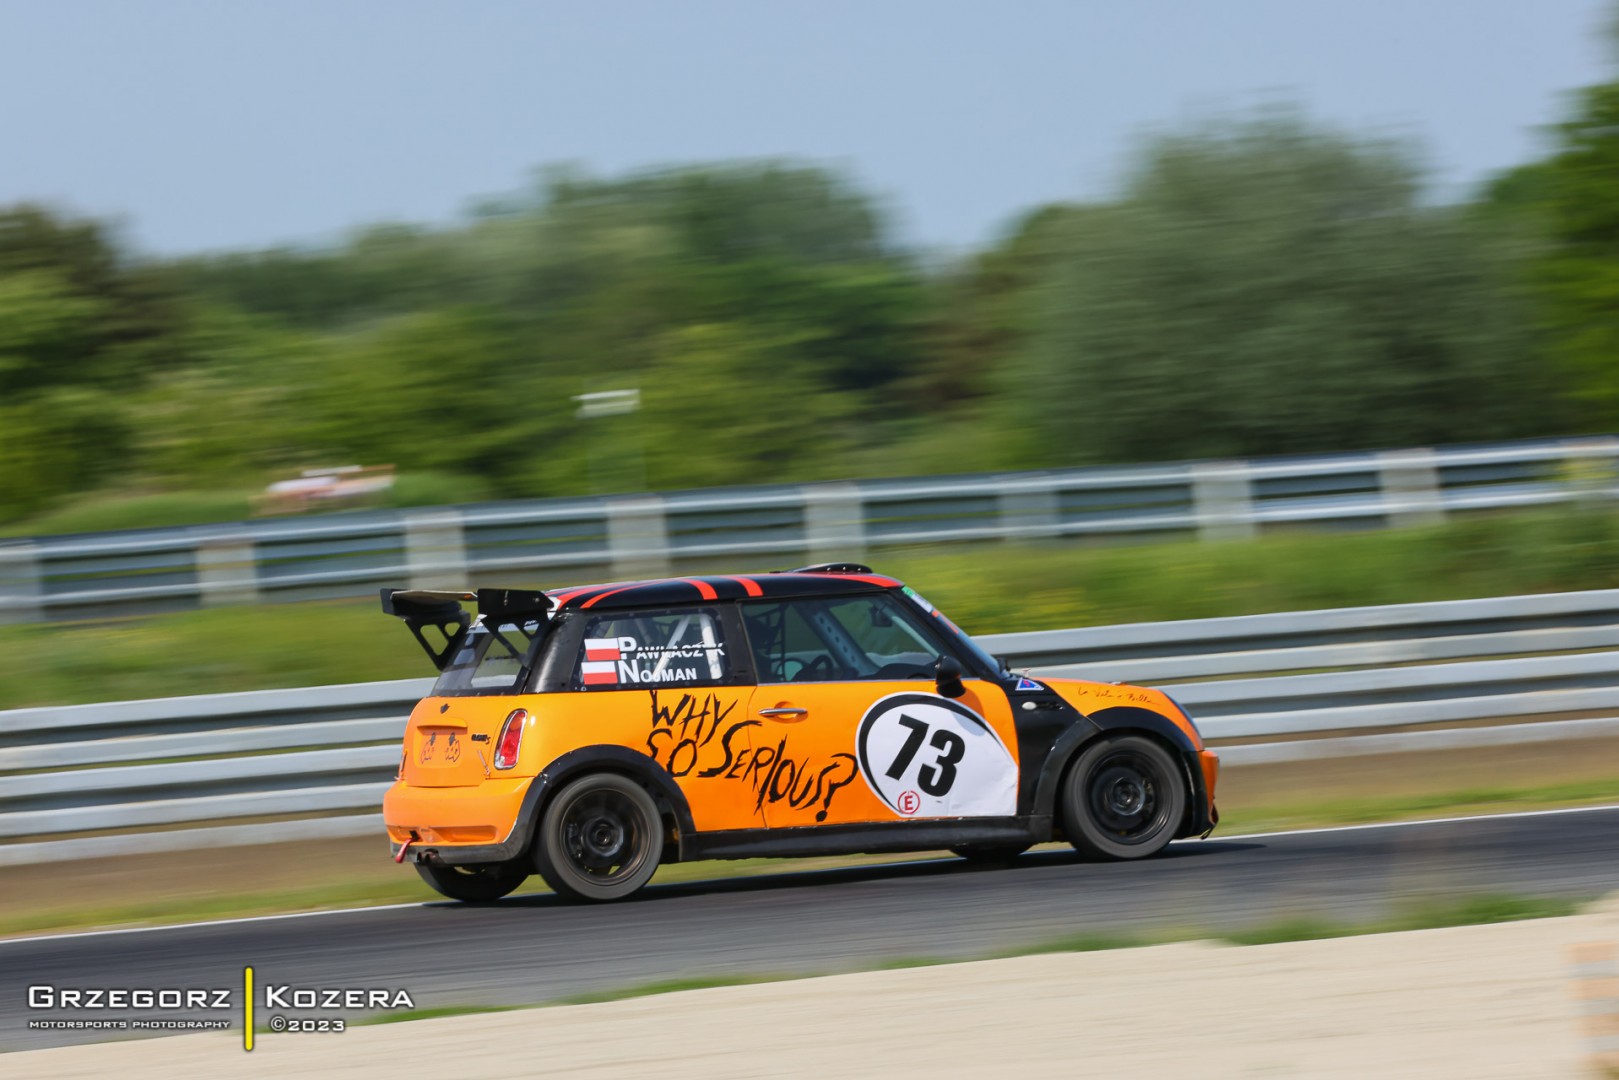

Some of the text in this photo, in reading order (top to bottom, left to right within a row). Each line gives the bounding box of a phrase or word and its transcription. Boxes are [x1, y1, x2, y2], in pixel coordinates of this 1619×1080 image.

[649, 689, 738, 747] WHY
[884, 713, 966, 797] 73
[646, 720, 859, 822] SO SERIOUS?
